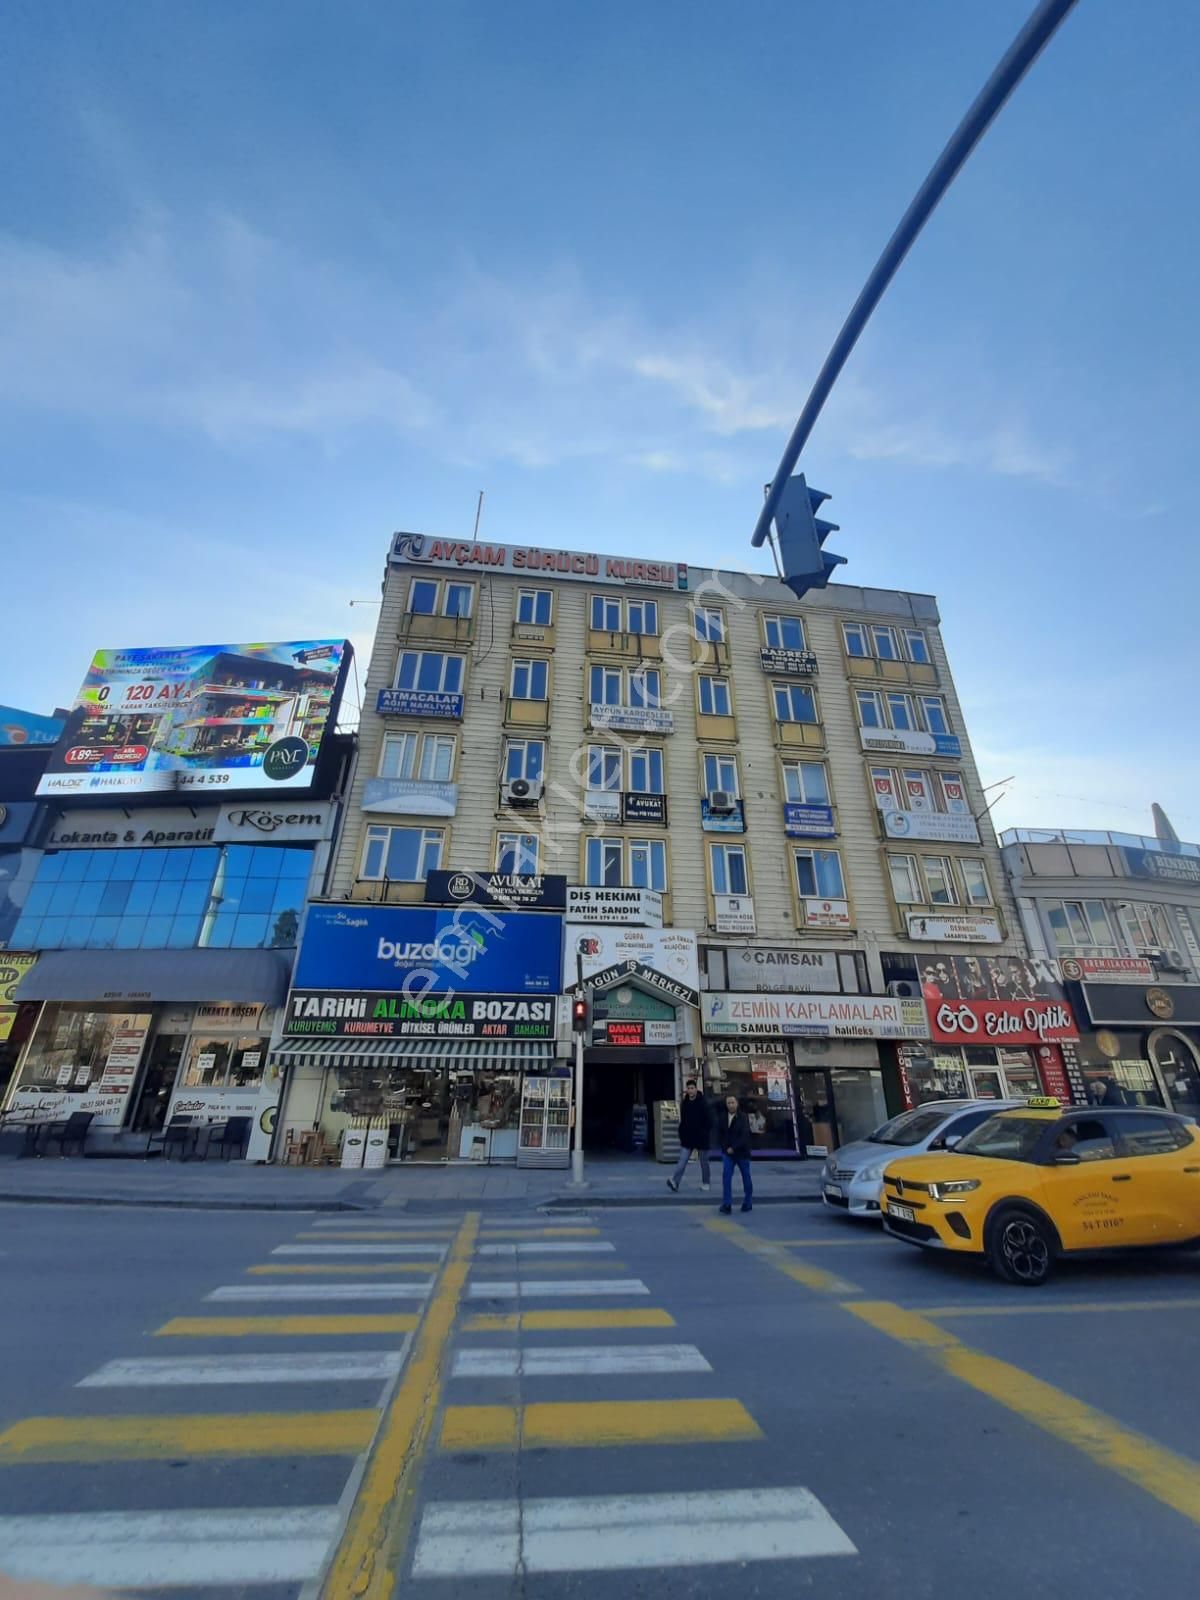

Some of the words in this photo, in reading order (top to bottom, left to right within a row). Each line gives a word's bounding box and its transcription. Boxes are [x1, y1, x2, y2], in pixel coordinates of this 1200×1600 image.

[429, 540, 505, 566] AYÇAM
[513, 548, 599, 576] SÜRÜCÜ
[606, 559, 675, 584] KURSU
[126, 685, 155, 701] 120
[382, 691, 460, 704] ATMACALAR
[49, 831, 118, 844] Lokanta
[123, 830, 135, 842] &
[142, 828, 215, 845] Aparatif
[488, 875, 545, 888] AVUKAT
[569, 889, 591, 903] DİŞ
[595, 890, 641, 902] HEKİMİ
[569, 905, 598, 914] FATİH
[601, 906, 641, 915] SANDIK
[377, 936, 477, 967] buzdağı
[642, 968, 693, 1001] MERKEZİ
[472, 1001, 551, 1021] BOZASI
[731, 998, 781, 1019] ZEMİN
[785, 1001, 898, 1021] KAPLAMALARI
[287, 1020, 338, 1033] KURUYEMİŞ
[344, 1021, 395, 1034] KURUMEYVE
[401, 1020, 436, 1034] BİTKİSEL
[437, 1021, 475, 1035] ÜRÜNLER
[481, 1023, 508, 1035] AKTAR
[608, 1023, 642, 1033] DAMAT
[740, 1023, 780, 1033] SAMUR
[984, 1010, 1023, 1036] Eda
[1023, 1005, 1072, 1042] Optik
[712, 1042, 751, 1054] KARO
